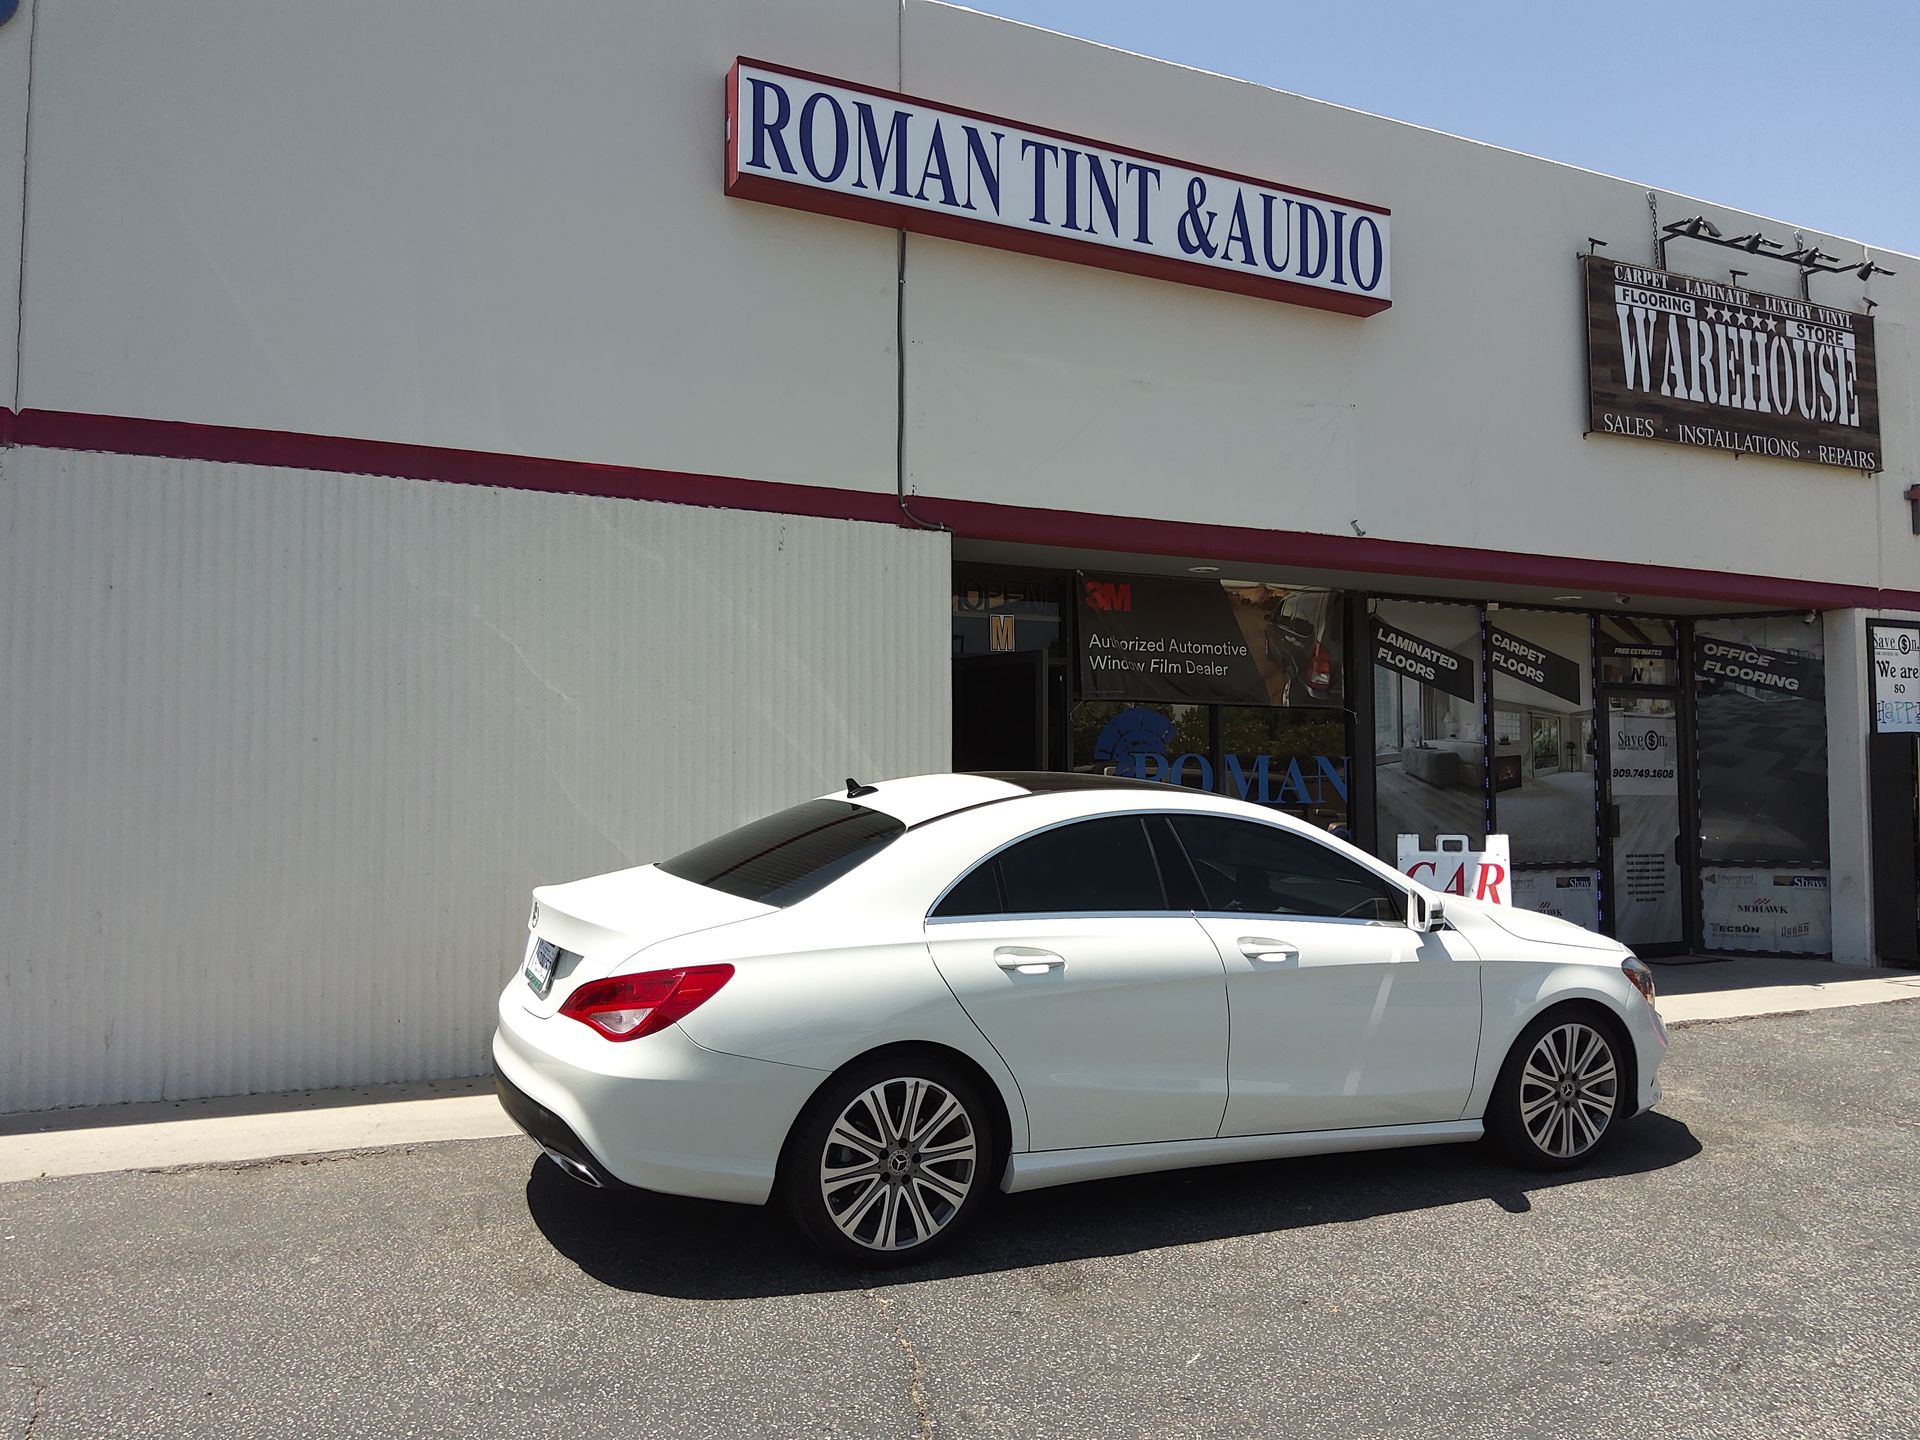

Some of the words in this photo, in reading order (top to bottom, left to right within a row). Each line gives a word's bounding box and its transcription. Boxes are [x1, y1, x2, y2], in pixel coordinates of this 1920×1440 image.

[745, 77, 1005, 216] ROMAN
[1021, 139, 1161, 245] TINT
[1614, 265, 1669, 290] CARPET
[1685, 279, 1750, 307] LAMINATE
[1764, 297, 1813, 319] LUXURY
[1818, 307, 1853, 328] VINYL
[1622, 288, 1692, 313] FLOORING
[1796, 323, 1844, 347] STORE
[1615, 303, 1859, 428] WAREHOUSE
[1603, 413, 1654, 437] SALES
[1678, 425, 1800, 458] INSTALLATIONS
[1818, 445, 1875, 469] REPAIRS
[1086, 581, 1131, 612] 3M
[989, 614, 1015, 652] M
[1088, 633, 1164, 653] Authorized
[1169, 637, 1247, 657] Automotive
[1376, 628, 1459, 672] LAMINATED
[1491, 633, 1546, 665] CARPET
[1703, 642, 1775, 668] OFFICE
[1089, 655, 1145, 673] Window
[1149, 658, 1182, 675] Film
[1186, 660, 1229, 677] Dealer
[1377, 647, 1436, 681] FLOORS
[1492, 653, 1545, 684] FLOORS
[1702, 660, 1800, 692] FLOORING
[1876, 660, 1897, 678] We
[1900, 666, 1919, 679] are
[1894, 684, 1906, 694] so
[1617, 730, 1643, 747] Save
[1612, 768, 1674, 779] 909.749.1608
[1794, 877, 1826, 888] Shaw
[1737, 904, 1788, 914] MOHAWK
